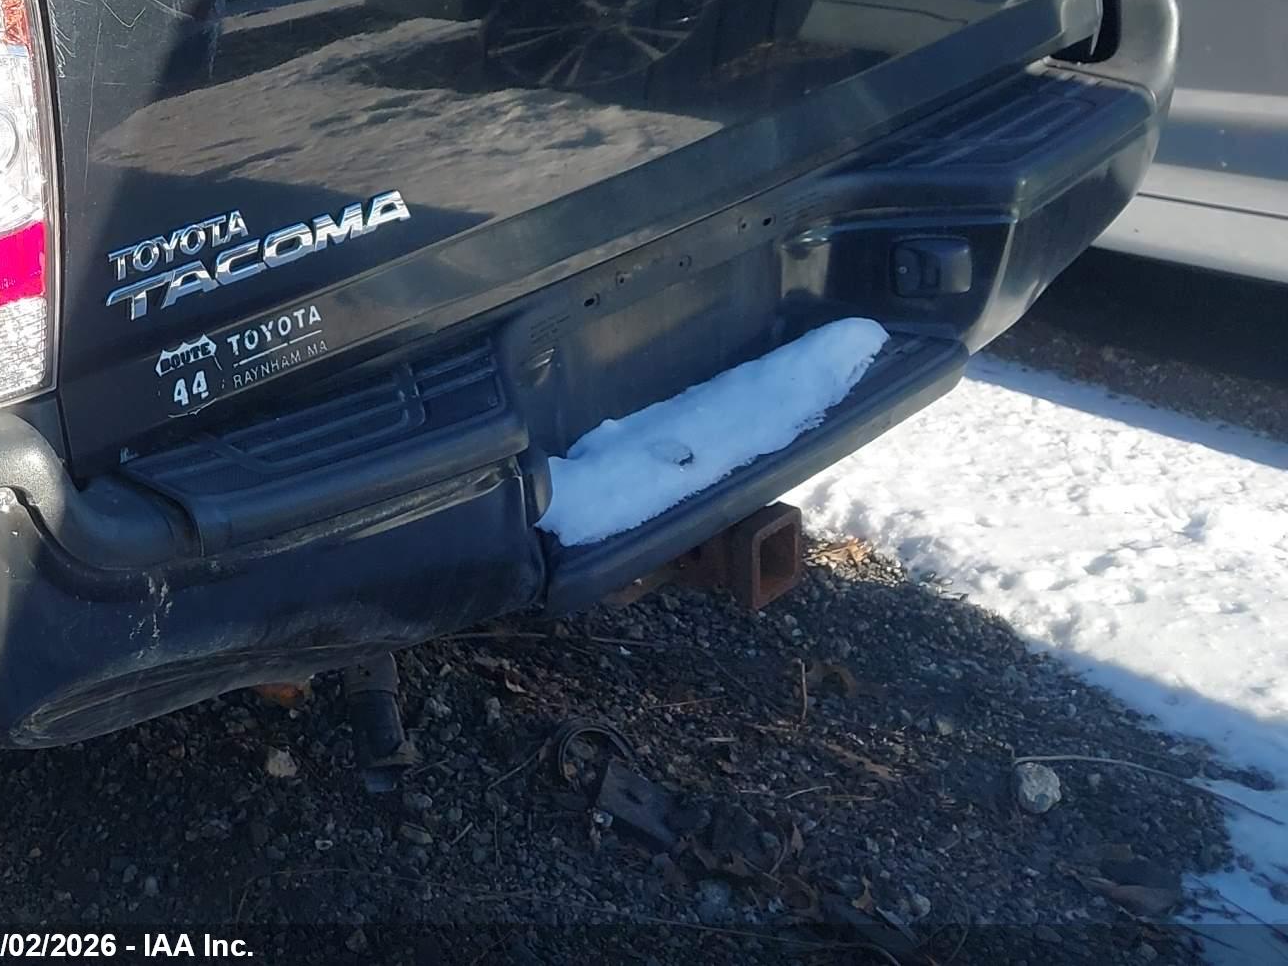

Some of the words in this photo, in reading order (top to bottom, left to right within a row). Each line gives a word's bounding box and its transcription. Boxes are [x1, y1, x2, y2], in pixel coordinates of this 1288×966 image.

[105, 190, 411, 321] TACOMA
[108, 210, 249, 282] TOYOTA
[226, 305, 322, 356] TOYOTA
[173, 370, 210, 407] 44
[233, 350, 302, 389] RAYNHAM
[307, 340, 328, 357] MA
